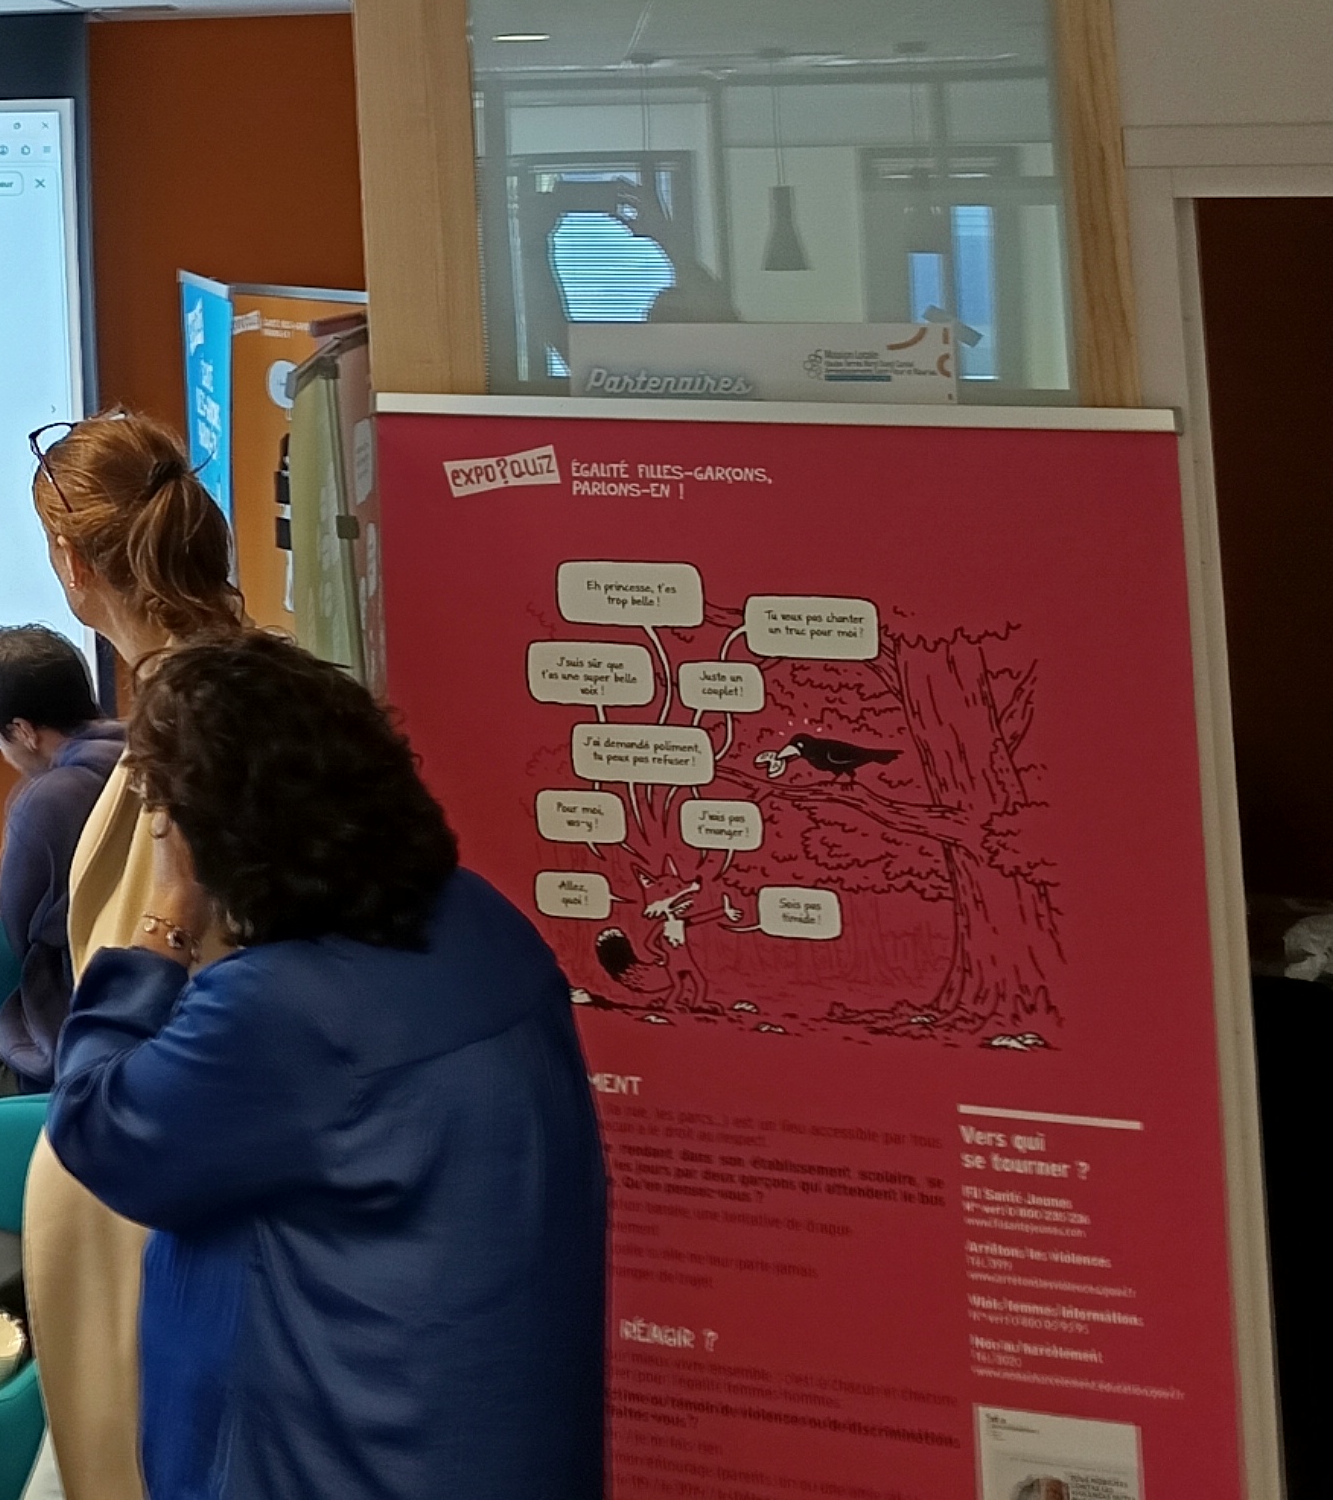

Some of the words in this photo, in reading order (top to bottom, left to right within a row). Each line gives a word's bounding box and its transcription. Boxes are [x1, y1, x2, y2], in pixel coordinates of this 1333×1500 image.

[586, 367, 754, 395] Partenaires
[571, 459, 629, 478] ÉGALITÉ
[637, 463, 773, 485] FILLES-GARÇONS,
[572, 483, 670, 498] PARLONS-EN
[678, 483, 684, 499] !
[587, 581, 601, 590] Eh
[604, 582, 654, 594] princesse,
[657, 583, 677, 594] t'es
[607, 596, 628, 609] trop
[631, 596, 654, 606] belle
[765, 610, 778, 621] Tu
[781, 613, 802, 622] veux
[806, 614, 822, 628] pas
[826, 612, 865, 624] chanter
[768, 627, 781, 635] un
[785, 626, 806, 636] truc
[810, 628, 832, 640] pour
[837, 629, 857, 638] moi
[556, 656, 584, 667] J'suis
[587, 658, 602, 668] sûr
[607, 662, 624, 672] que
[541, 670, 559, 679] t'es
[561, 673, 580, 681] une
[583, 673, 610, 685] super
[614, 673, 637, 683] belle
[699, 670, 726, 682] Juste
[580, 686, 599, 694] voix
[582, 735, 600, 747] J'ai
[603, 737, 650, 750] demandé
[653, 739, 703, 755] poliment,
[593, 751, 604, 762] tu
[606, 754, 630, 765] peux
[632, 754, 650, 767] pas
[652, 755, 690, 766] refuser
[556, 802, 578, 814] Pour
[581, 805, 604, 816] moi,
[698, 811, 725, 823] J'vais
[729, 814, 746, 825] pas
[566, 820, 593, 832] vas-y
[697, 824, 744, 840] t'manger
[558, 881, 588, 892] Allez,
[561, 895, 583, 907] quoi
[779, 898, 800, 910] Sois
[804, 902, 822, 912] pas
[782, 913, 815, 924] timide
[958, 1124, 1008, 1148] Vers
[1011, 1131, 1046, 1153] qui
[960, 1152, 986, 1169] se
[990, 1152, 1071, 1178] tourner
[1075, 1160, 1090, 1180] ?
[619, 1315, 696, 1349] RÉAGIR
[702, 1329, 719, 1352] ?
